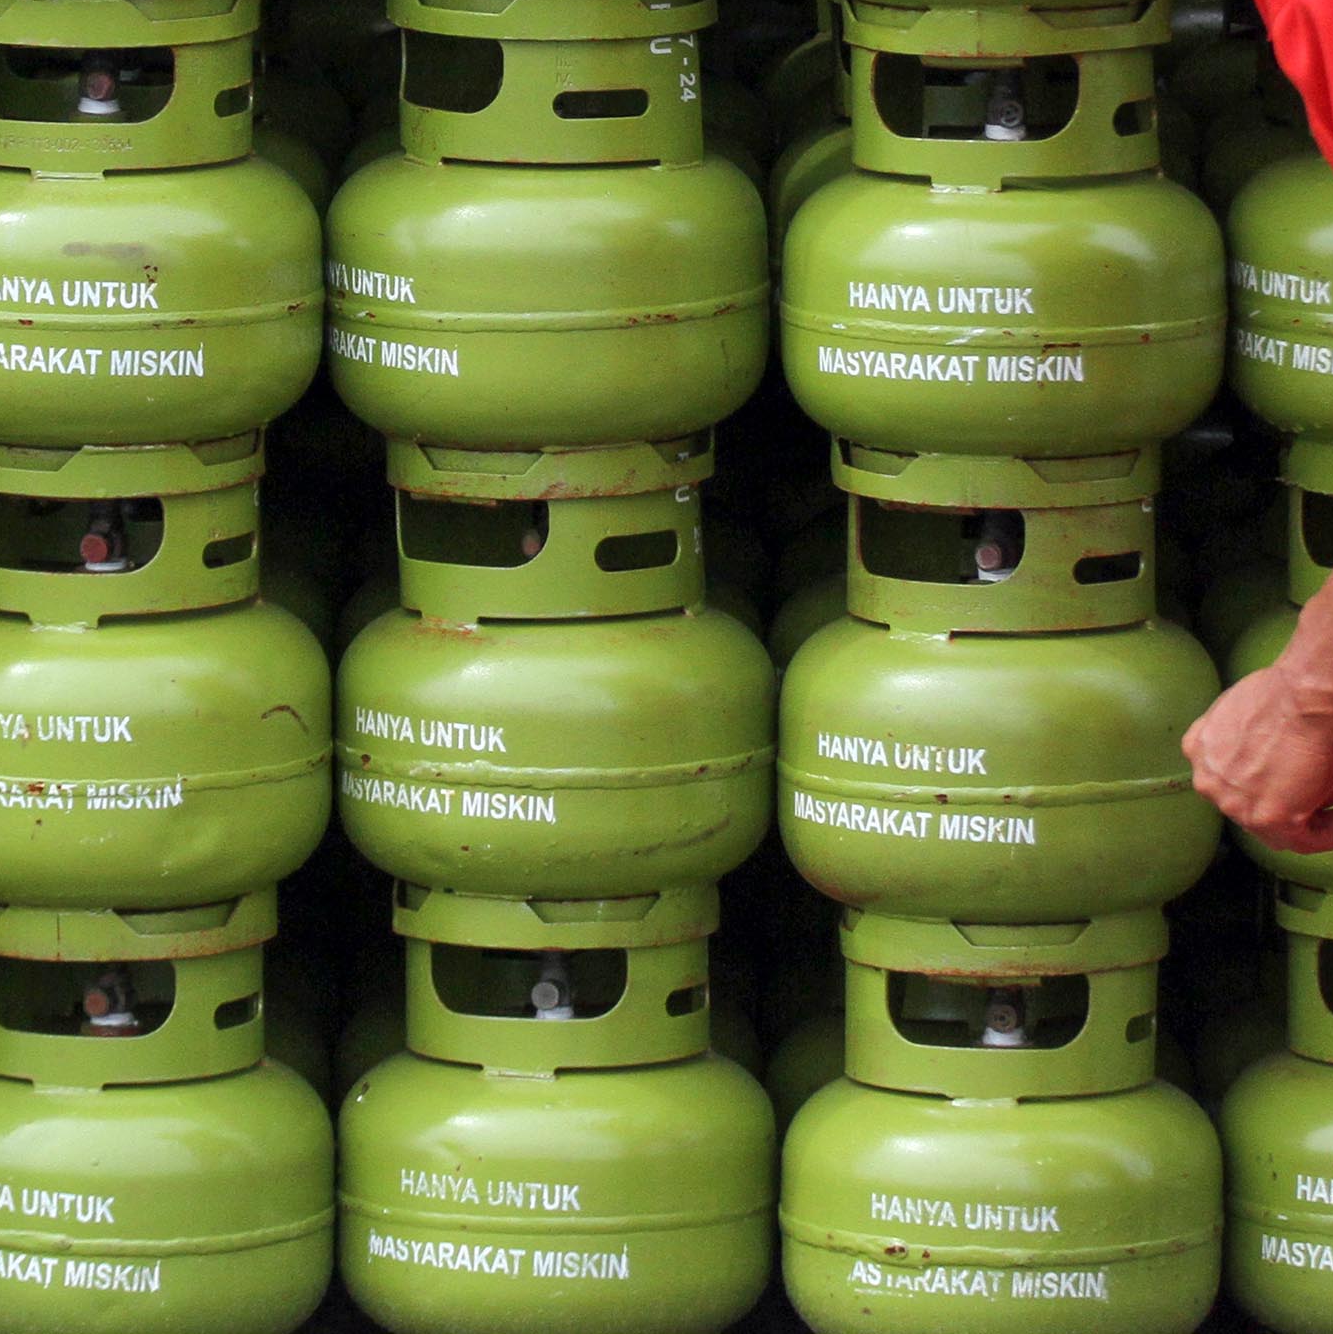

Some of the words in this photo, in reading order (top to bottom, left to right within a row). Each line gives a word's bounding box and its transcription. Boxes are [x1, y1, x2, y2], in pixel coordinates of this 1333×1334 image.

[62, 280, 159, 309] UNTUK
[352, 268, 416, 304] UNTUK
[849, 281, 932, 313] HANYA
[937, 286, 1034, 315] UNTUK
[1261, 272, 1332, 305] UNTUK
[109, 348, 204, 377] MISKIN
[381, 340, 459, 377] MISKIN
[818, 346, 980, 382] MASYARAKAT
[986, 355, 1084, 382] MISKIN
[37, 715, 133, 743] UNTUK
[356, 709, 415, 744] HANYA
[420, 720, 507, 753] UNTUK
[818, 733, 889, 767] HANYA
[894, 742, 987, 775] UNTUK
[461, 790, 557, 824] MISKIN
[794, 791, 933, 838] MASYARAKAT
[938, 813, 1036, 845] MISKIN
[21, 1188, 115, 1224] UNTUK
[400, 1168, 480, 1205] HANYA
[487, 1180, 581, 1211] UNTUK
[871, 1193, 958, 1228] HANYA
[964, 1203, 1060, 1233] UNTUK
[369, 1230, 526, 1276] MASYARAKAT
[532, 1246, 630, 1280] MISKIN
[63, 1260, 161, 1293] MISKIN
[1011, 1271, 1107, 1300] MISKIN
